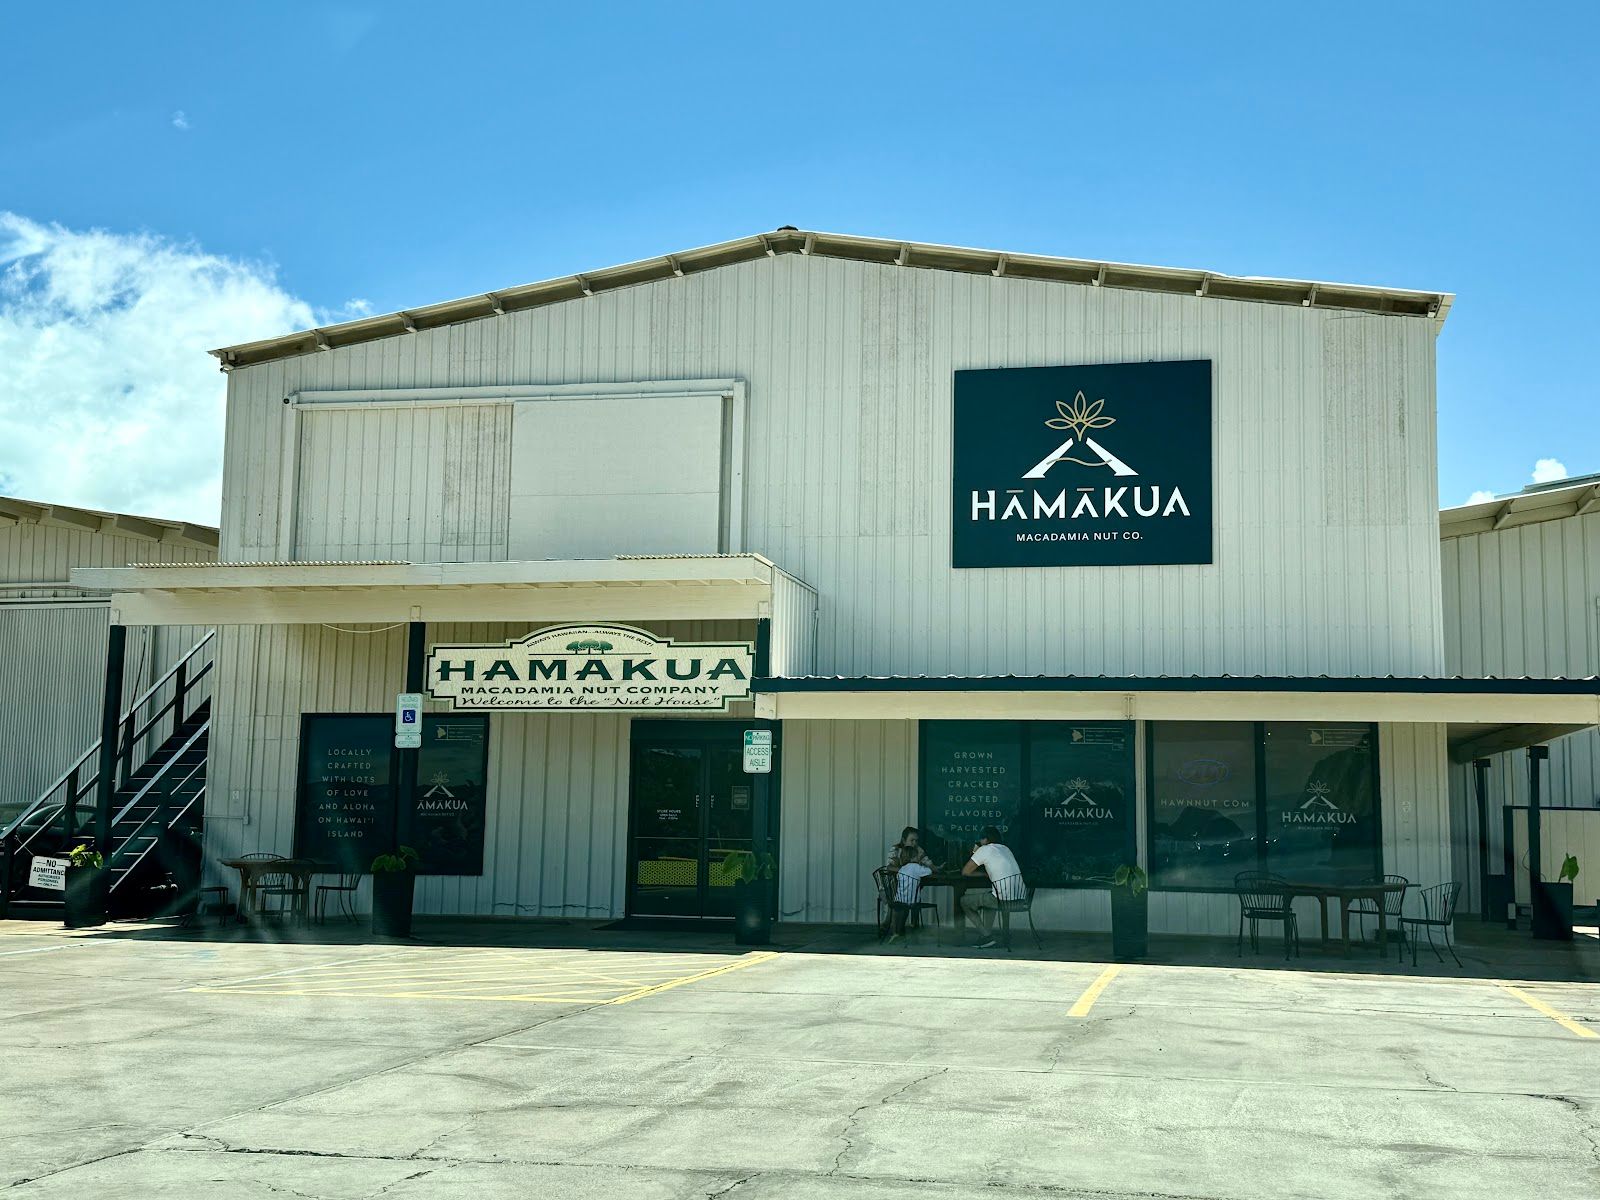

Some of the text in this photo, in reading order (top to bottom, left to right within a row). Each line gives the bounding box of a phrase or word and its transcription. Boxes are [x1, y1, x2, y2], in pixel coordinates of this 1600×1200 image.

[971, 485, 1191, 521] HĀMĀKUA
[1016, 531, 1144, 542] MACADAMIA NUT CO.
[622, 633, 635, 642] THE
[436, 658, 748, 682] HAMAKUA
[461, 686, 720, 695] MACADAMIA NUT COMPANY
[462, 696, 543, 706] Welcome
[547, 696, 563, 706] to
[569, 696, 600, 706] the
[328, 748, 372, 756] LOCALLY
[747, 747, 769, 756] ACCESS
[953, 751, 993, 759] GROWN
[327, 762, 371, 770] CRAFTED
[749, 758, 766, 767] AISLE
[941, 766, 1006, 774] HARVESTED
[321, 775, 375, 783] WITH LOTS
[948, 780, 999, 788] CRACKED
[326, 789, 369, 797] OF LOVE
[948, 795, 998, 803] ROASTED
[343, 803, 375, 811] ALOHA
[416, 799, 469, 810] ĀMĀKUA
[944, 810, 1002, 818] FLAVORED
[318, 816, 332, 824] ON
[327, 830, 364, 838] ISLAND
[45, 859, 57, 868] NO
[32, 866, 65, 876] ADMITTANC
